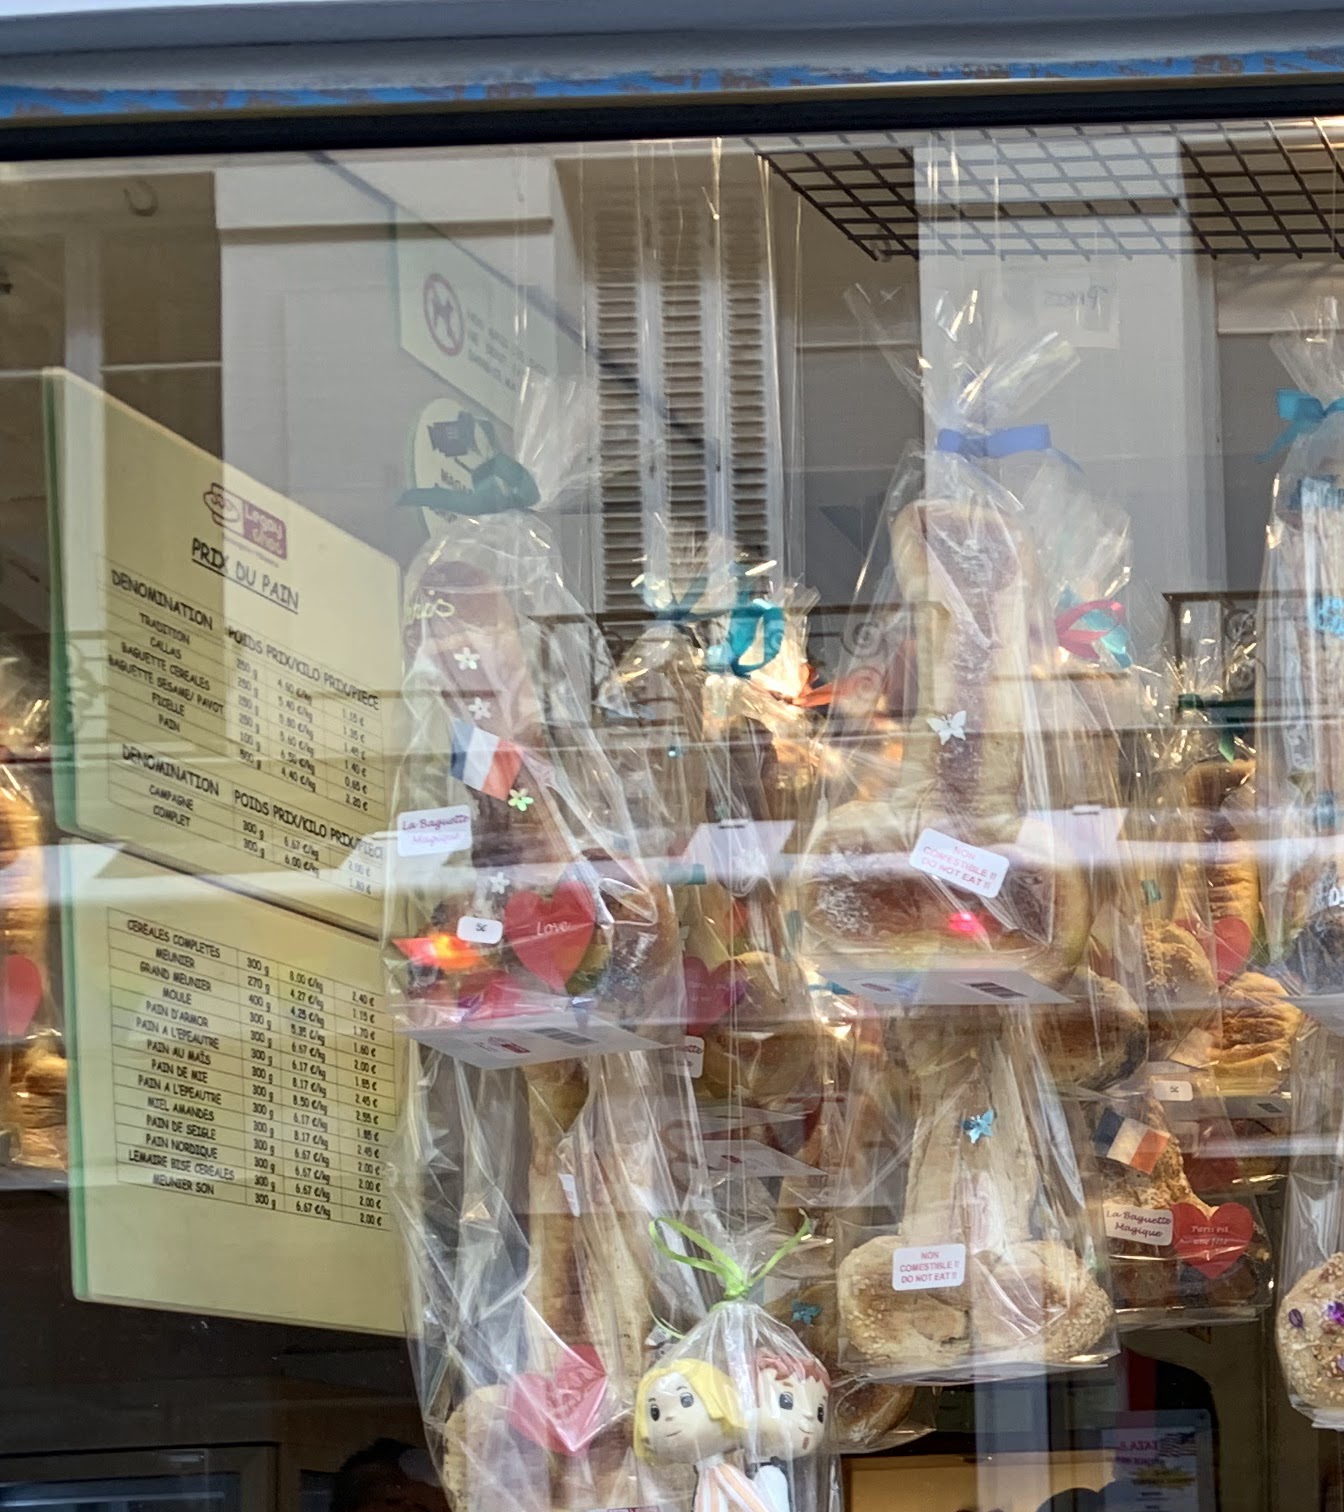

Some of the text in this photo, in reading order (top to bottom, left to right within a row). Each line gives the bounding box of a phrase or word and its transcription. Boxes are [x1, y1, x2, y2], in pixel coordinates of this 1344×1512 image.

[192, 537, 299, 609] PRIX DU PAIN
[112, 569, 213, 630] DENOMINATION
[122, 744, 327, 838] DENOMINATION POIDS PRIX/KILO
[537, 921, 571, 935] Love
[1123, 1212, 1172, 1225] Baguette
[1115, 1222, 1163, 1237] Magique
[921, 1252, 939, 1260] NON
[900, 1261, 953, 1272] COMESTIBLE
[901, 1272, 950, 1283] DO NOT EAT
